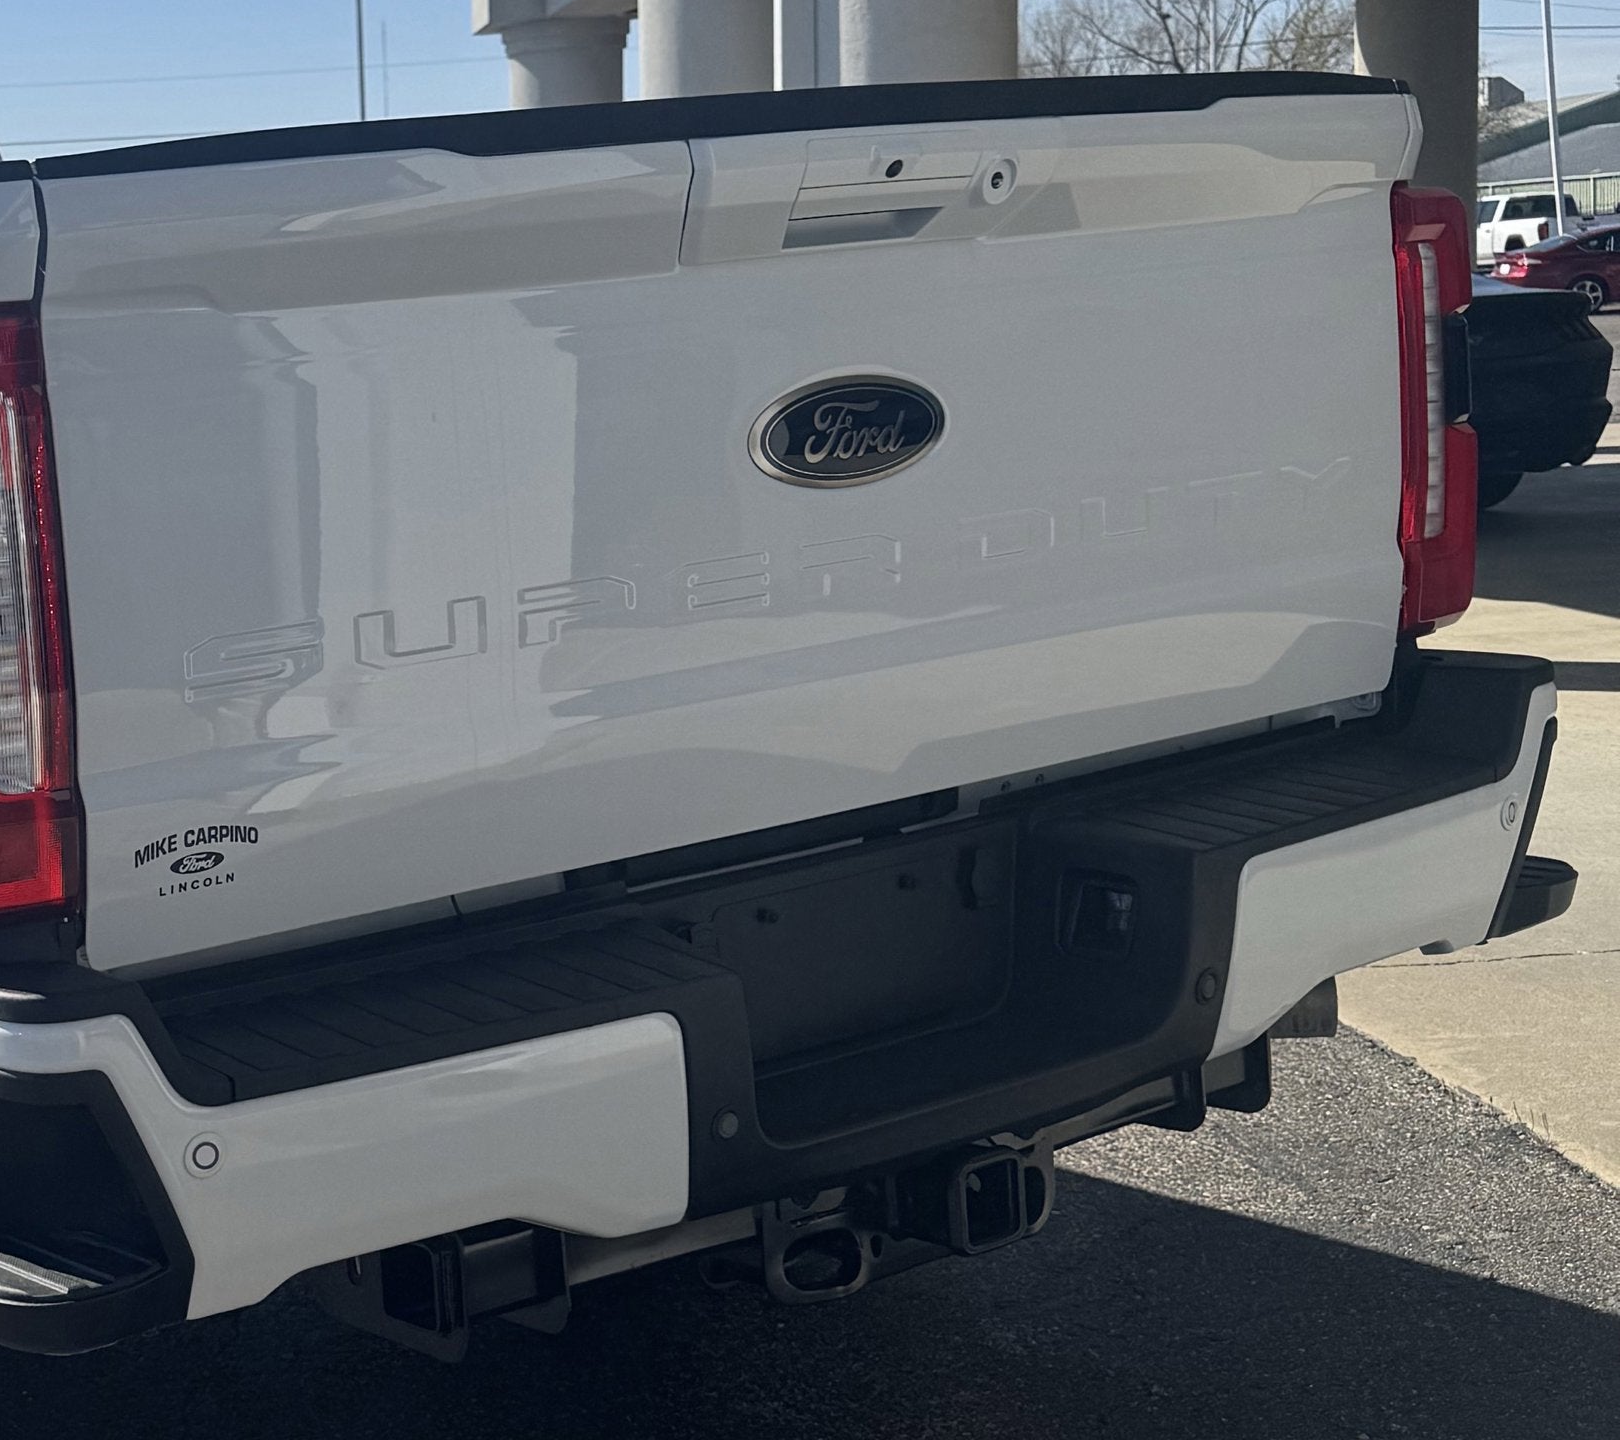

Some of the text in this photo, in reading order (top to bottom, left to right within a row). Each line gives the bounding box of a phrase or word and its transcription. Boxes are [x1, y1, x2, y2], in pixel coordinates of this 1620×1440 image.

[804, 399, 906, 464] Ford
[184, 456, 1352, 704] SUPER DUTY
[134, 825, 259, 869] MIKE CARPINO
[178, 852, 217, 874] Ford
[159, 872, 235, 897] LINCOLN
